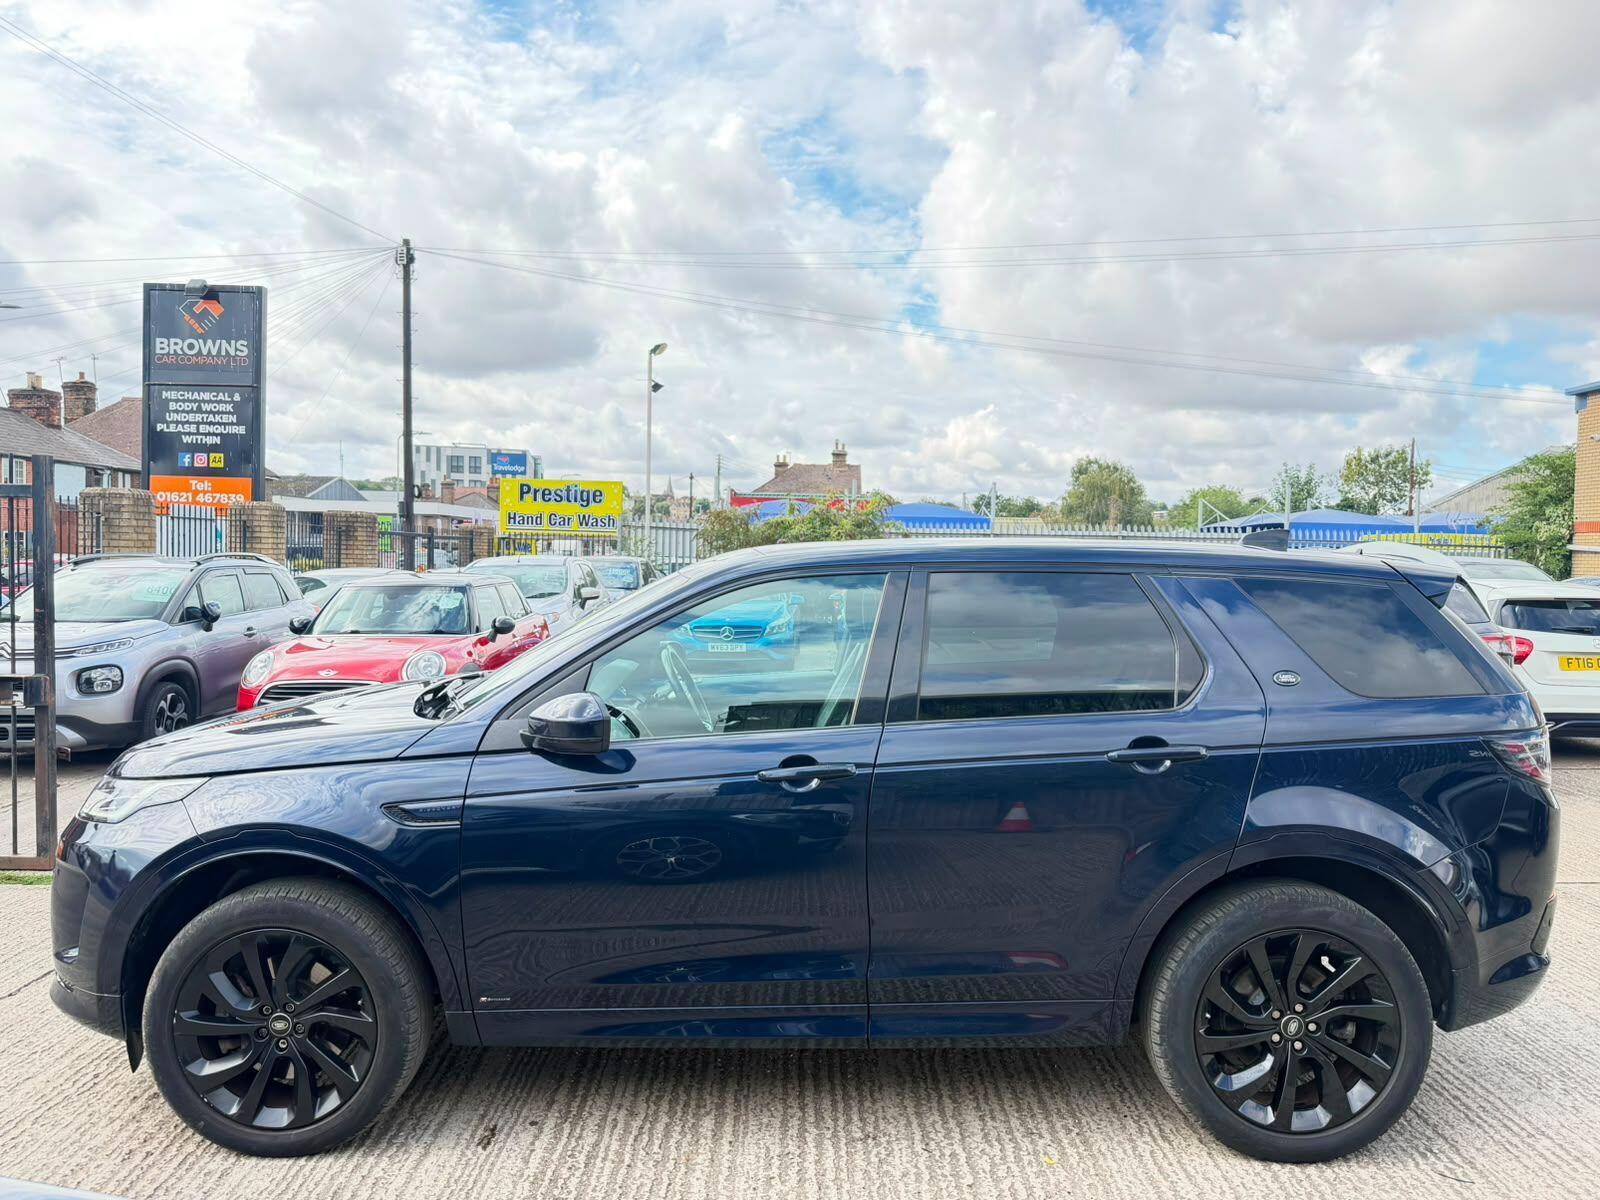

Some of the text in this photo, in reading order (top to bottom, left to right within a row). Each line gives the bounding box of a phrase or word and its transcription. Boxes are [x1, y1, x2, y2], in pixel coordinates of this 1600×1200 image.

[155, 337, 249, 356] BROWNS
[155, 355, 248, 366] CAR COMPANY LTD
[162, 390, 241, 401] MECHANICAL &
[168, 402, 234, 412] BODY WORK
[165, 412, 237, 423] UNDERTAKEN
[156, 423, 246, 434] PLEASE ENQUIRE
[181, 434, 221, 444] WITHIN
[493, 463, 525, 473] Travelodge
[189, 480, 212, 491] Tel:
[157, 491, 245, 505] 01621 467839
[519, 483, 603, 508] Prestige
[507, 512, 616, 528] Hand Car Wash
[1566, 657, 1594, 669] FT16
